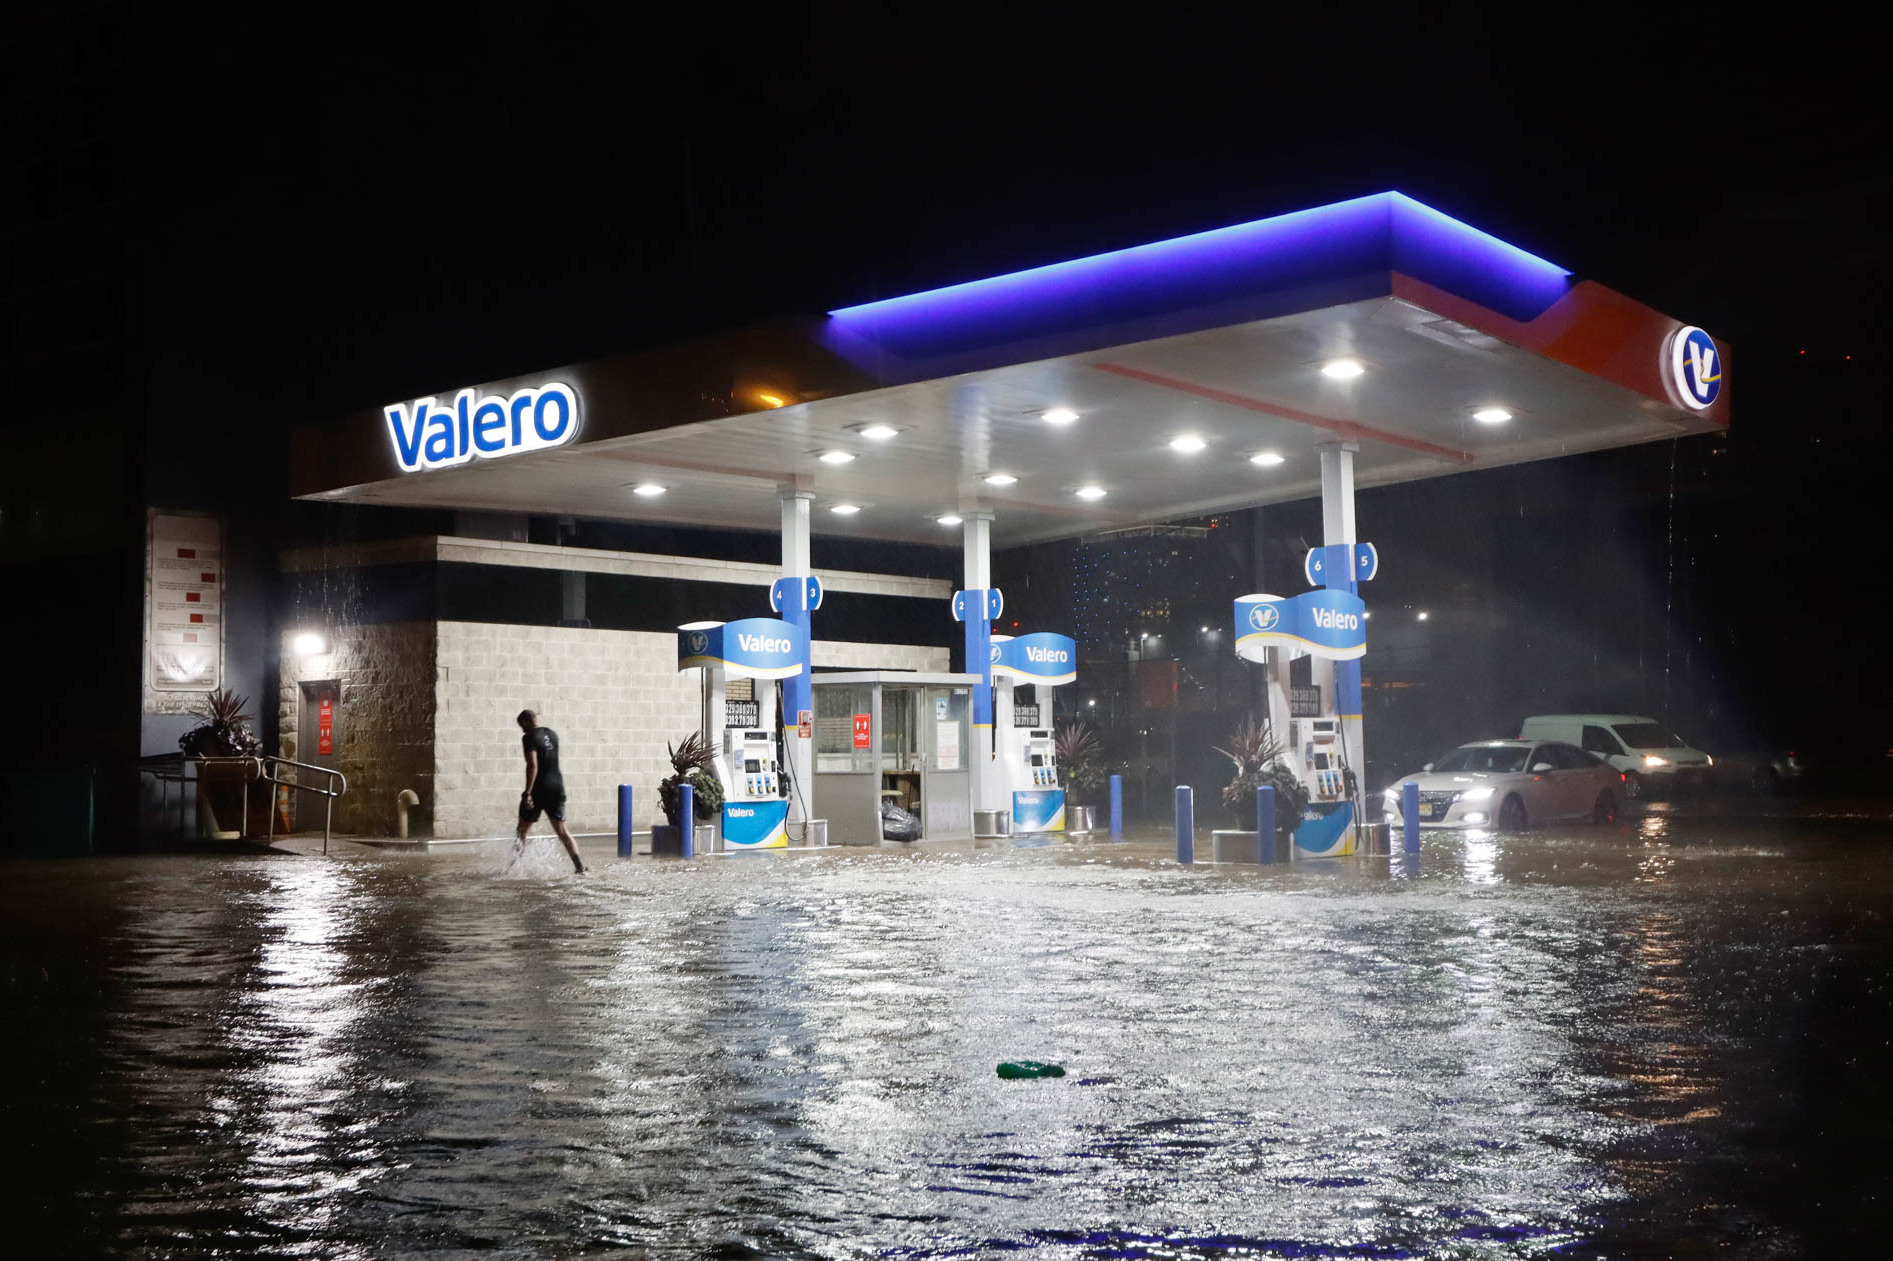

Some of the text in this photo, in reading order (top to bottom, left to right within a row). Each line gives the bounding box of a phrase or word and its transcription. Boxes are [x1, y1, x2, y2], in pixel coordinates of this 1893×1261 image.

[387, 386, 573, 469] Valero
[1314, 560, 1322, 572] 6
[1361, 555, 1368, 567] 5
[776, 590, 782, 600] 4
[810, 588, 816, 598] 3
[959, 601, 964, 610] 2
[991, 599, 996, 608] 1
[1312, 607, 1358, 631] Valero
[738, 633, 792, 654] Valero
[1026, 646, 1068, 663] Valero
[727, 807, 755, 817] Valero
